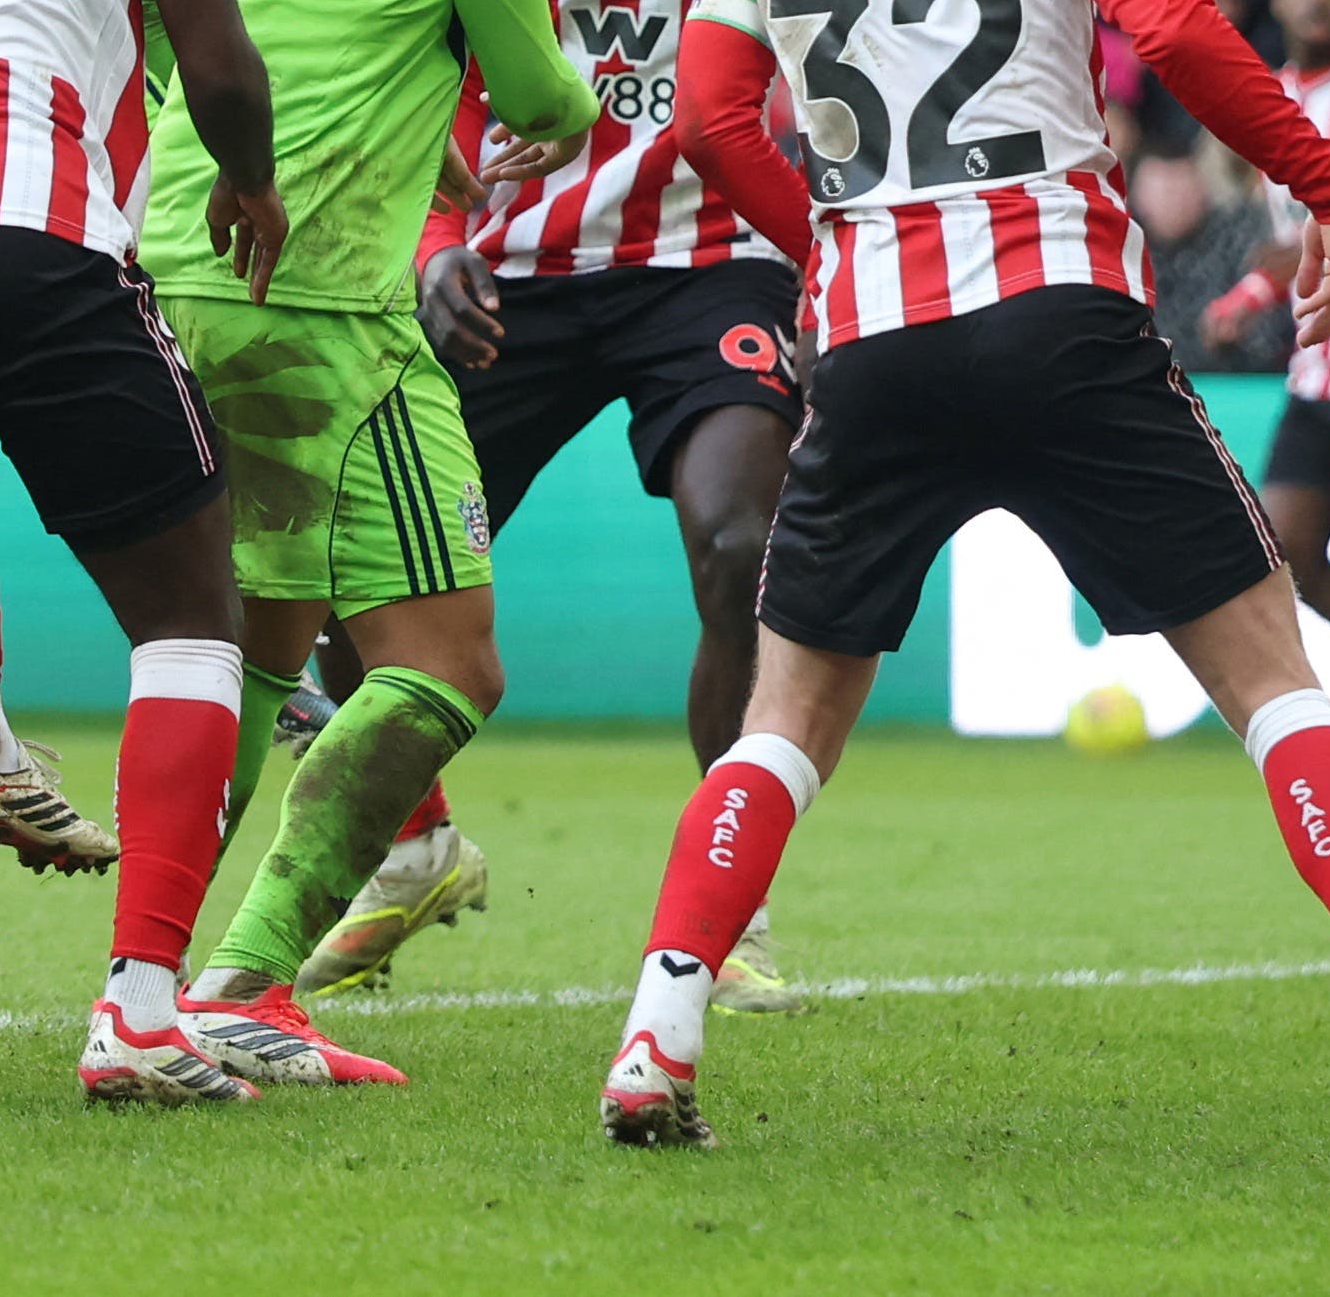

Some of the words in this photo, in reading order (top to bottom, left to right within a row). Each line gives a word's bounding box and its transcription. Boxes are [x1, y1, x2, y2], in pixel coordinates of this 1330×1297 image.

[597, 75, 676, 125] 88
[718, 323, 778, 373] 9
[708, 787, 749, 868] SAFC
